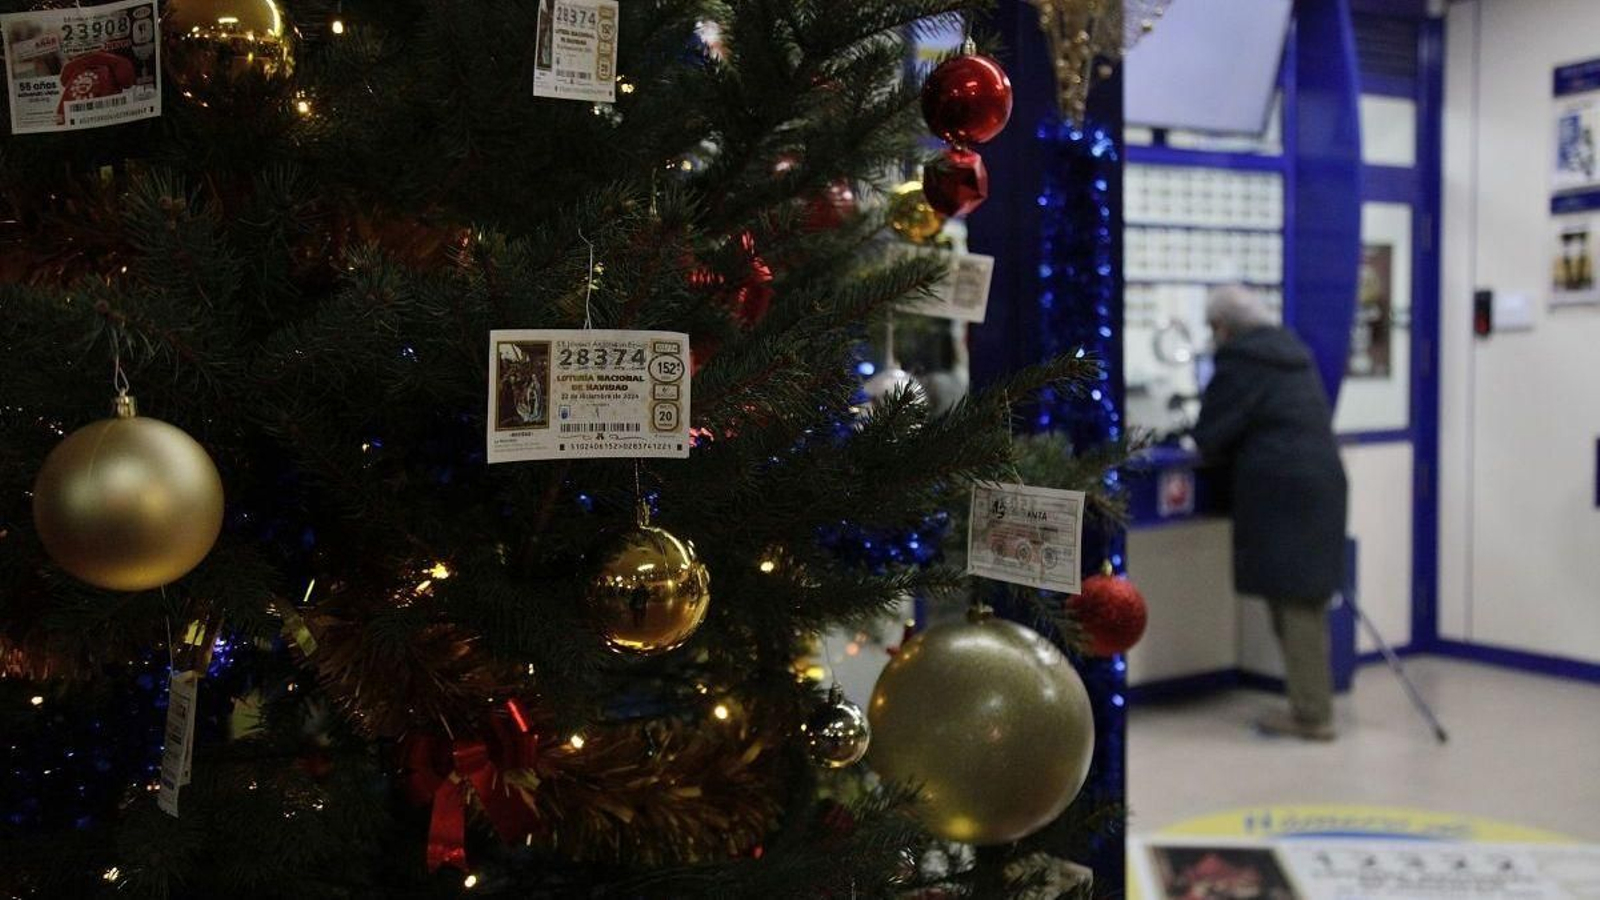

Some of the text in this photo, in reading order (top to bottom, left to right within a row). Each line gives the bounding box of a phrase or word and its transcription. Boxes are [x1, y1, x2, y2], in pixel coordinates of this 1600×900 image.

[61, 17, 129, 41] 23908
[33, 80, 57, 90] años
[559, 347, 646, 366] 28374
[556, 373, 646, 383] LOTERÍA NACIONAL
[586, 384, 629, 392] NAVIDAD
[579, 392, 611, 400] diciembre
[612, 392, 621, 400] de
[623, 392, 640, 400] 2024
[659, 411, 673, 422] 20
